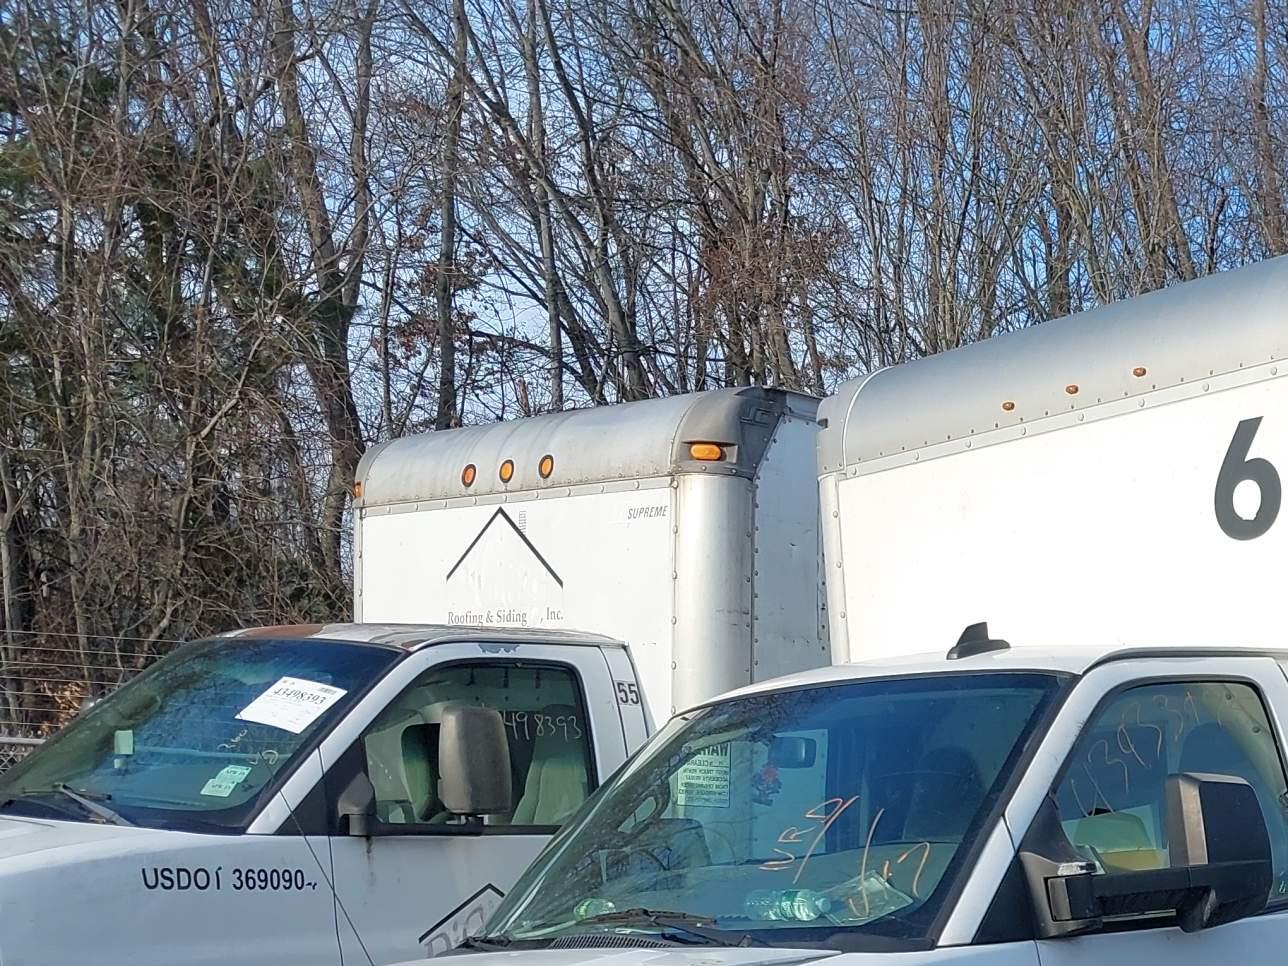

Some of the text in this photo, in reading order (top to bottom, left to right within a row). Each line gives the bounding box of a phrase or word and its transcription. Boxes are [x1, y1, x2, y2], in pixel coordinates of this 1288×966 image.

[1214, 415, 1282, 541] 6
[627, 505, 668, 520] SUPREME
[447, 611, 484, 625] Roofing
[485, 610, 494, 622] &
[496, 609, 528, 626] Siding
[546, 607, 564, 621] Inc.
[617, 682, 640, 704] 55
[503, 710, 582, 743] 498393
[232, 868, 318, 891] 369090
